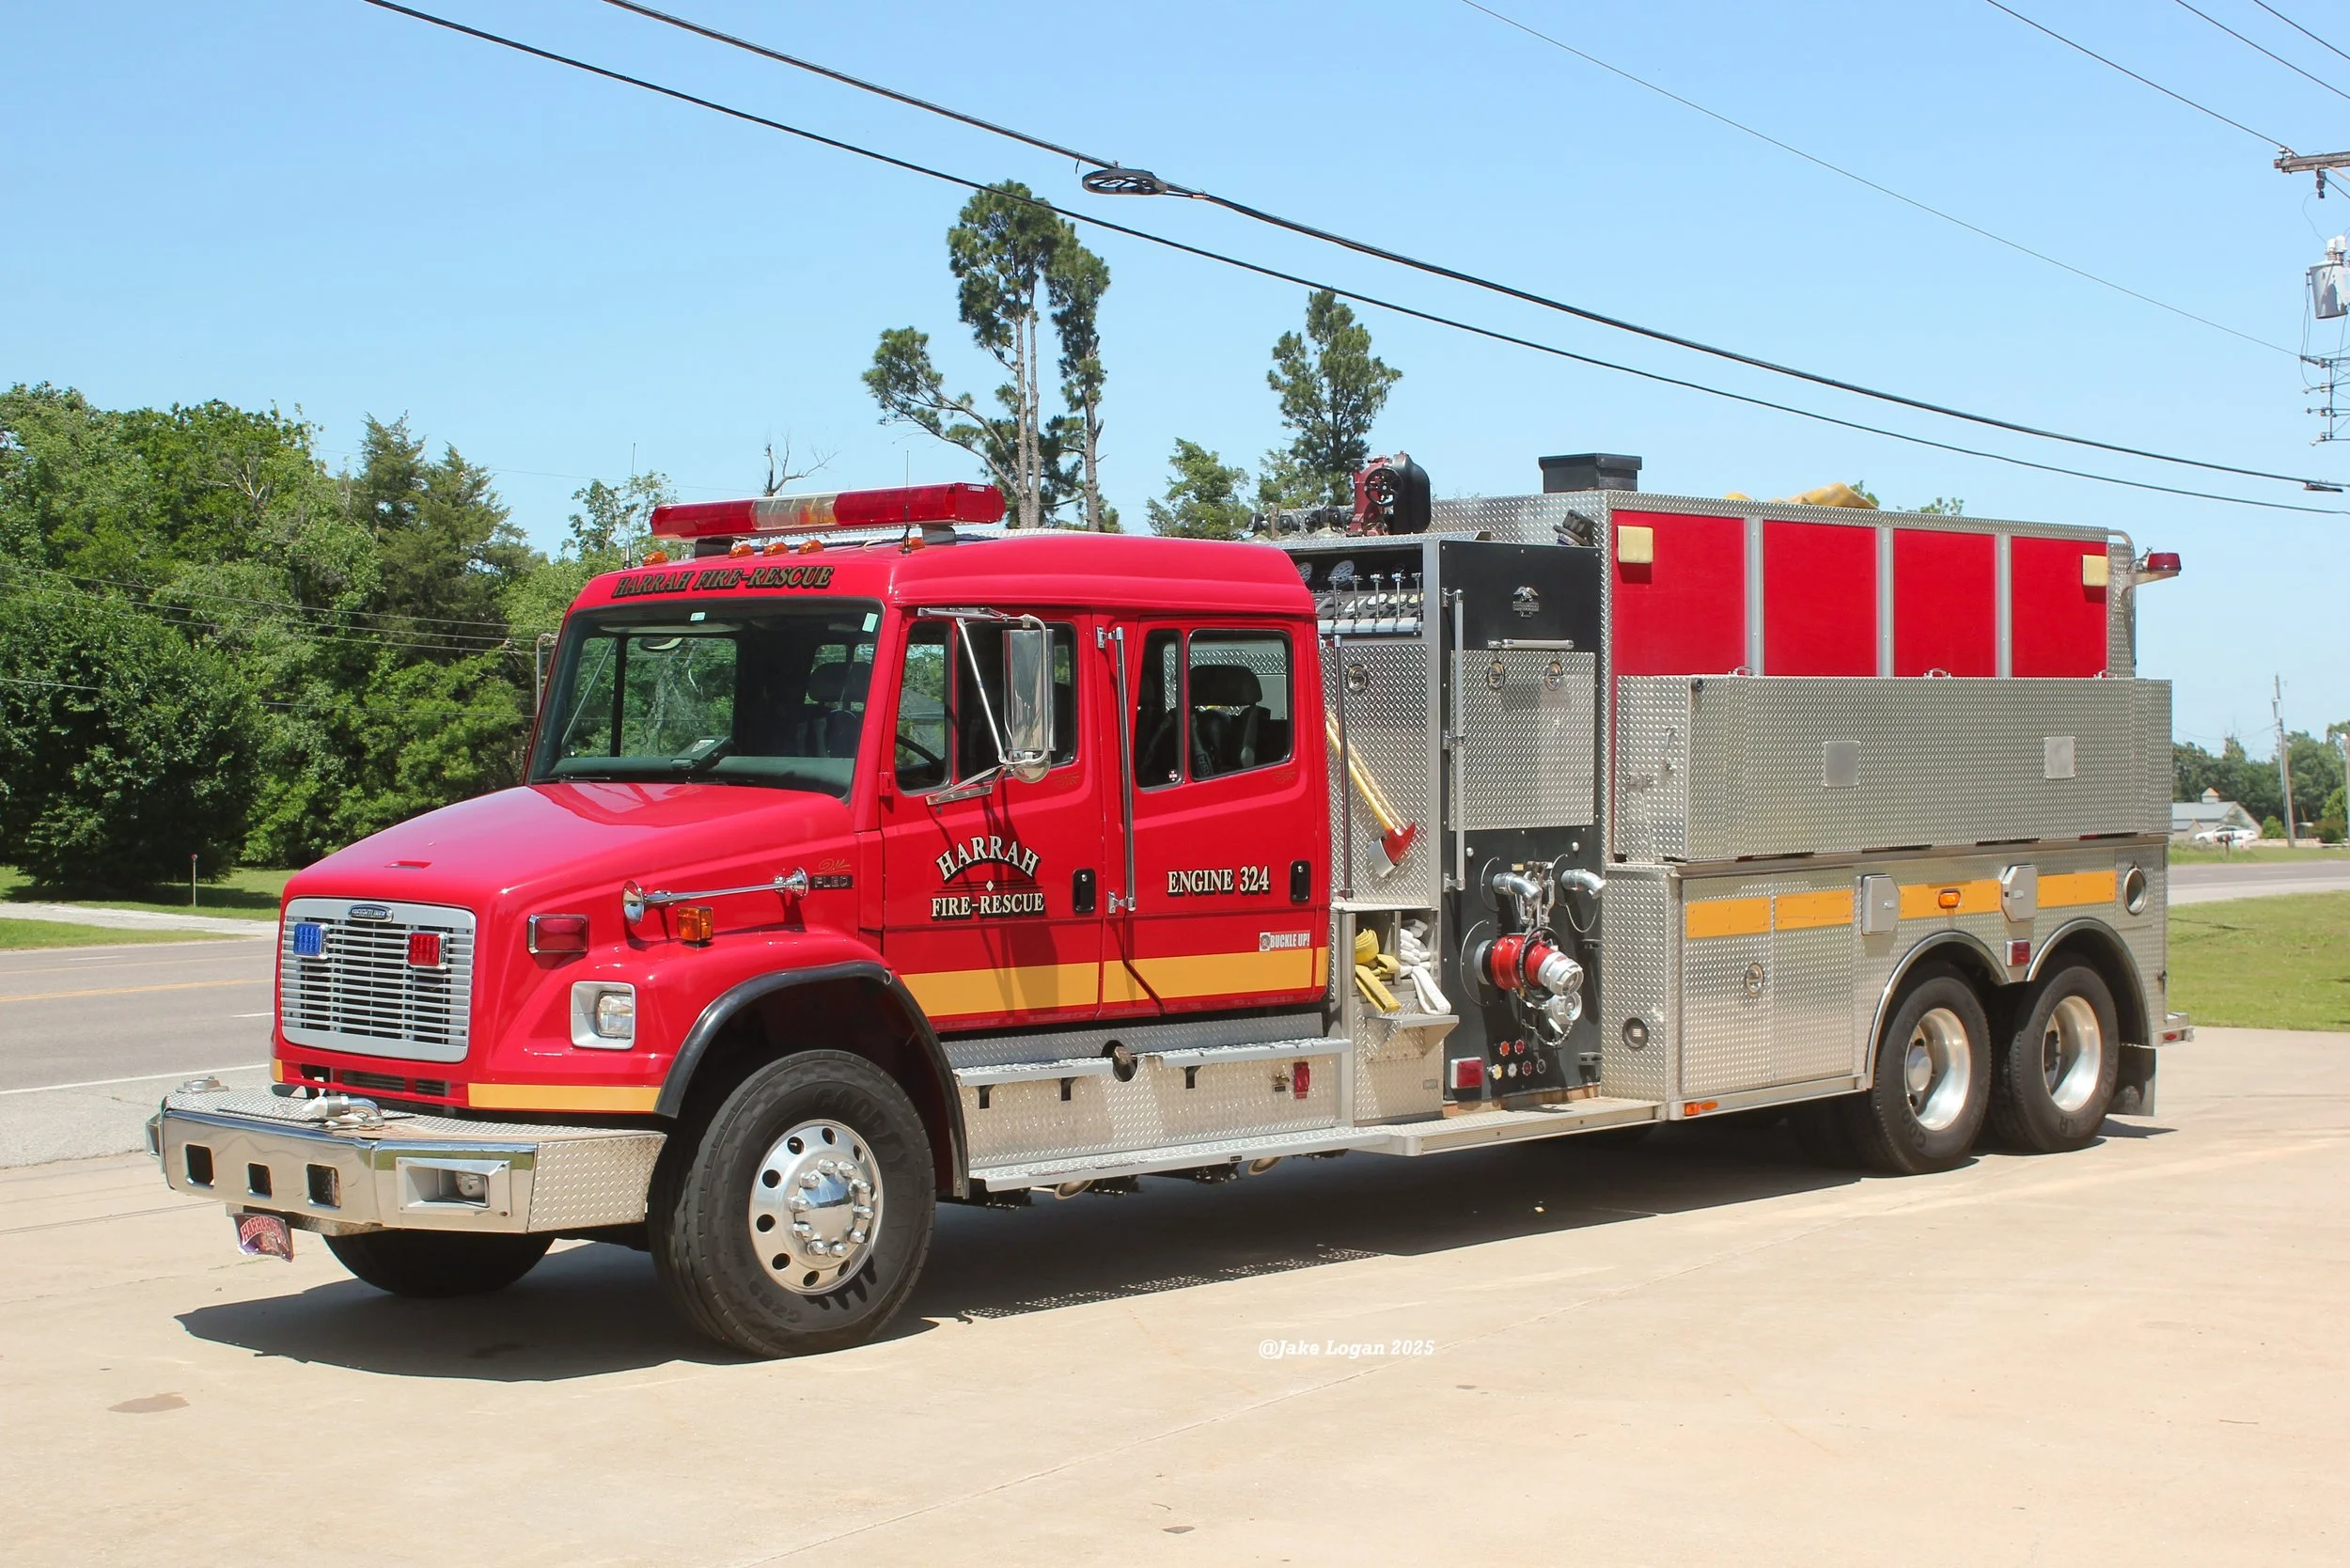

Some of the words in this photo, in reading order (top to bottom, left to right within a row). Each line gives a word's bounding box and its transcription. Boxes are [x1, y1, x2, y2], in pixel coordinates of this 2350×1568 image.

[612, 570, 695, 598] HARRAH
[693, 565, 835, 590] FIRE-RESCUE
[935, 835, 1042, 880] HARRAH
[1167, 869, 1234, 896] ENGINE
[1239, 865, 1270, 893] 324
[931, 892, 1044, 919] FIRE-RESCUE
[1270, 934, 1297, 949] BUCKLE
[1298, 933, 1310, 947] UP!
